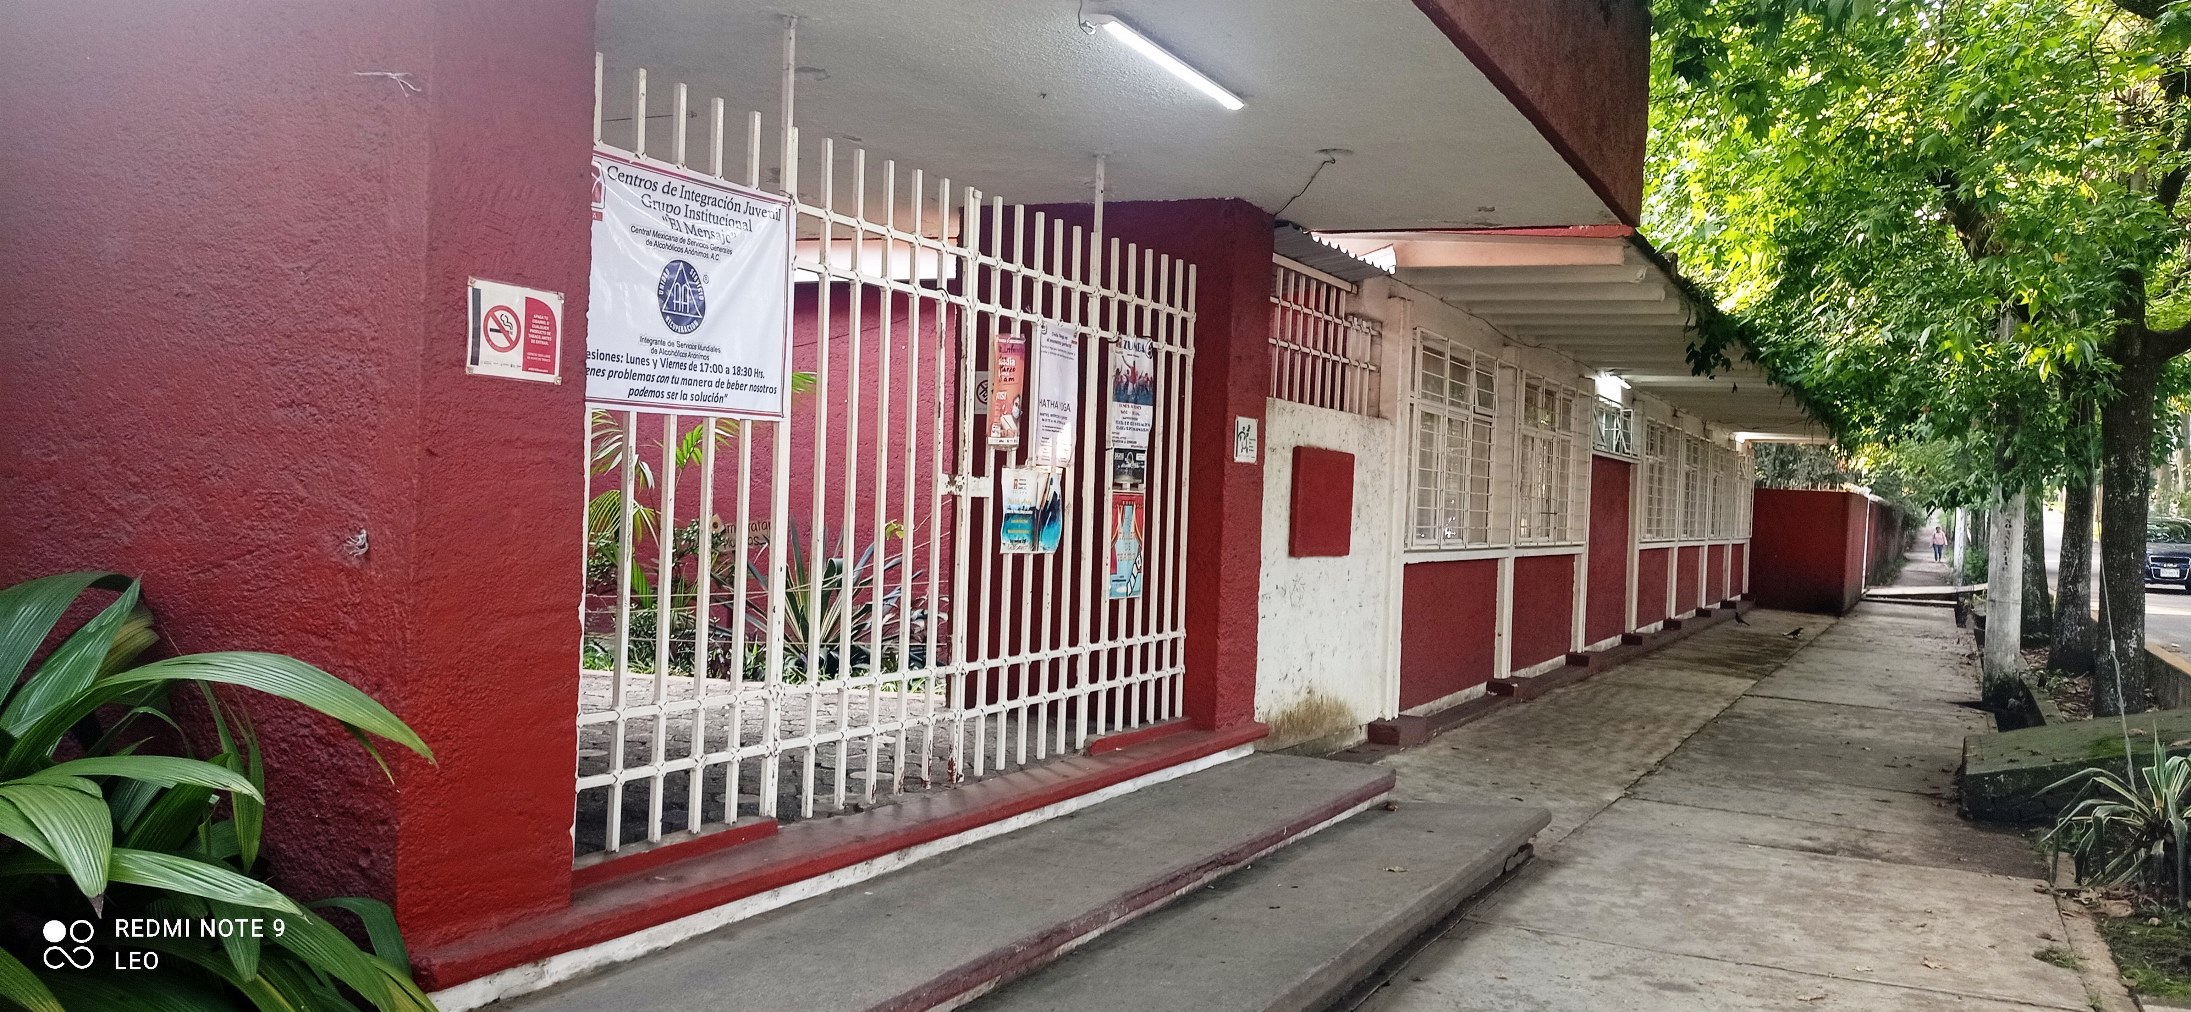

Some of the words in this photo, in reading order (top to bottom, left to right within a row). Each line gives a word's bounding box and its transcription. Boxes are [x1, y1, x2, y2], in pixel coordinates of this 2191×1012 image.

[607, 165, 658, 191] Centros
[662, 181, 677, 196] de
[679, 185, 741, 213] Integración
[743, 201, 781, 221] Juvenil
[641, 193, 681, 216] Grupo
[684, 204, 752, 232] Institucional
[630, 225, 652, 237] Central
[652, 230, 679, 243] Mexicana
[680, 236, 686, 245] de
[686, 238, 709, 249] Servicios
[709, 243, 733, 255] Generales
[645, 239, 653, 247] de
[653, 241, 684, 253] Alcohólicos
[673, 282, 689, 313] AA
[640, 336, 666, 346] Integrante
[676, 341, 697, 350] Servicios
[659, 347, 687, 358] Alcohólicos
[687, 352, 710, 361] Anónimos
[586, 349, 624, 364] esiones:
[625, 352, 650, 366] Lunes
[652, 358, 658, 369] y
[660, 357, 687, 371] Viernes
[688, 361, 698, 372] de
[699, 362, 723, 374] 17:00
[725, 367, 730, 375] a
[732, 365, 752, 377] 18:30
[753, 368, 765, 379] Hrs.
[586, 367, 606, 377] enes
[607, 368, 655, 382] problemas
[656, 375, 670, 384] con
[671, 374, 680, 385] tu
[680, 376, 713, 388] manera
[715, 378, 724, 389] de
[726, 379, 748, 391] beber
[749, 384, 777, 395] nosotros
[627, 386, 665, 399] podemos
[666, 391, 679, 400] ser
[680, 390, 688, 400] la
